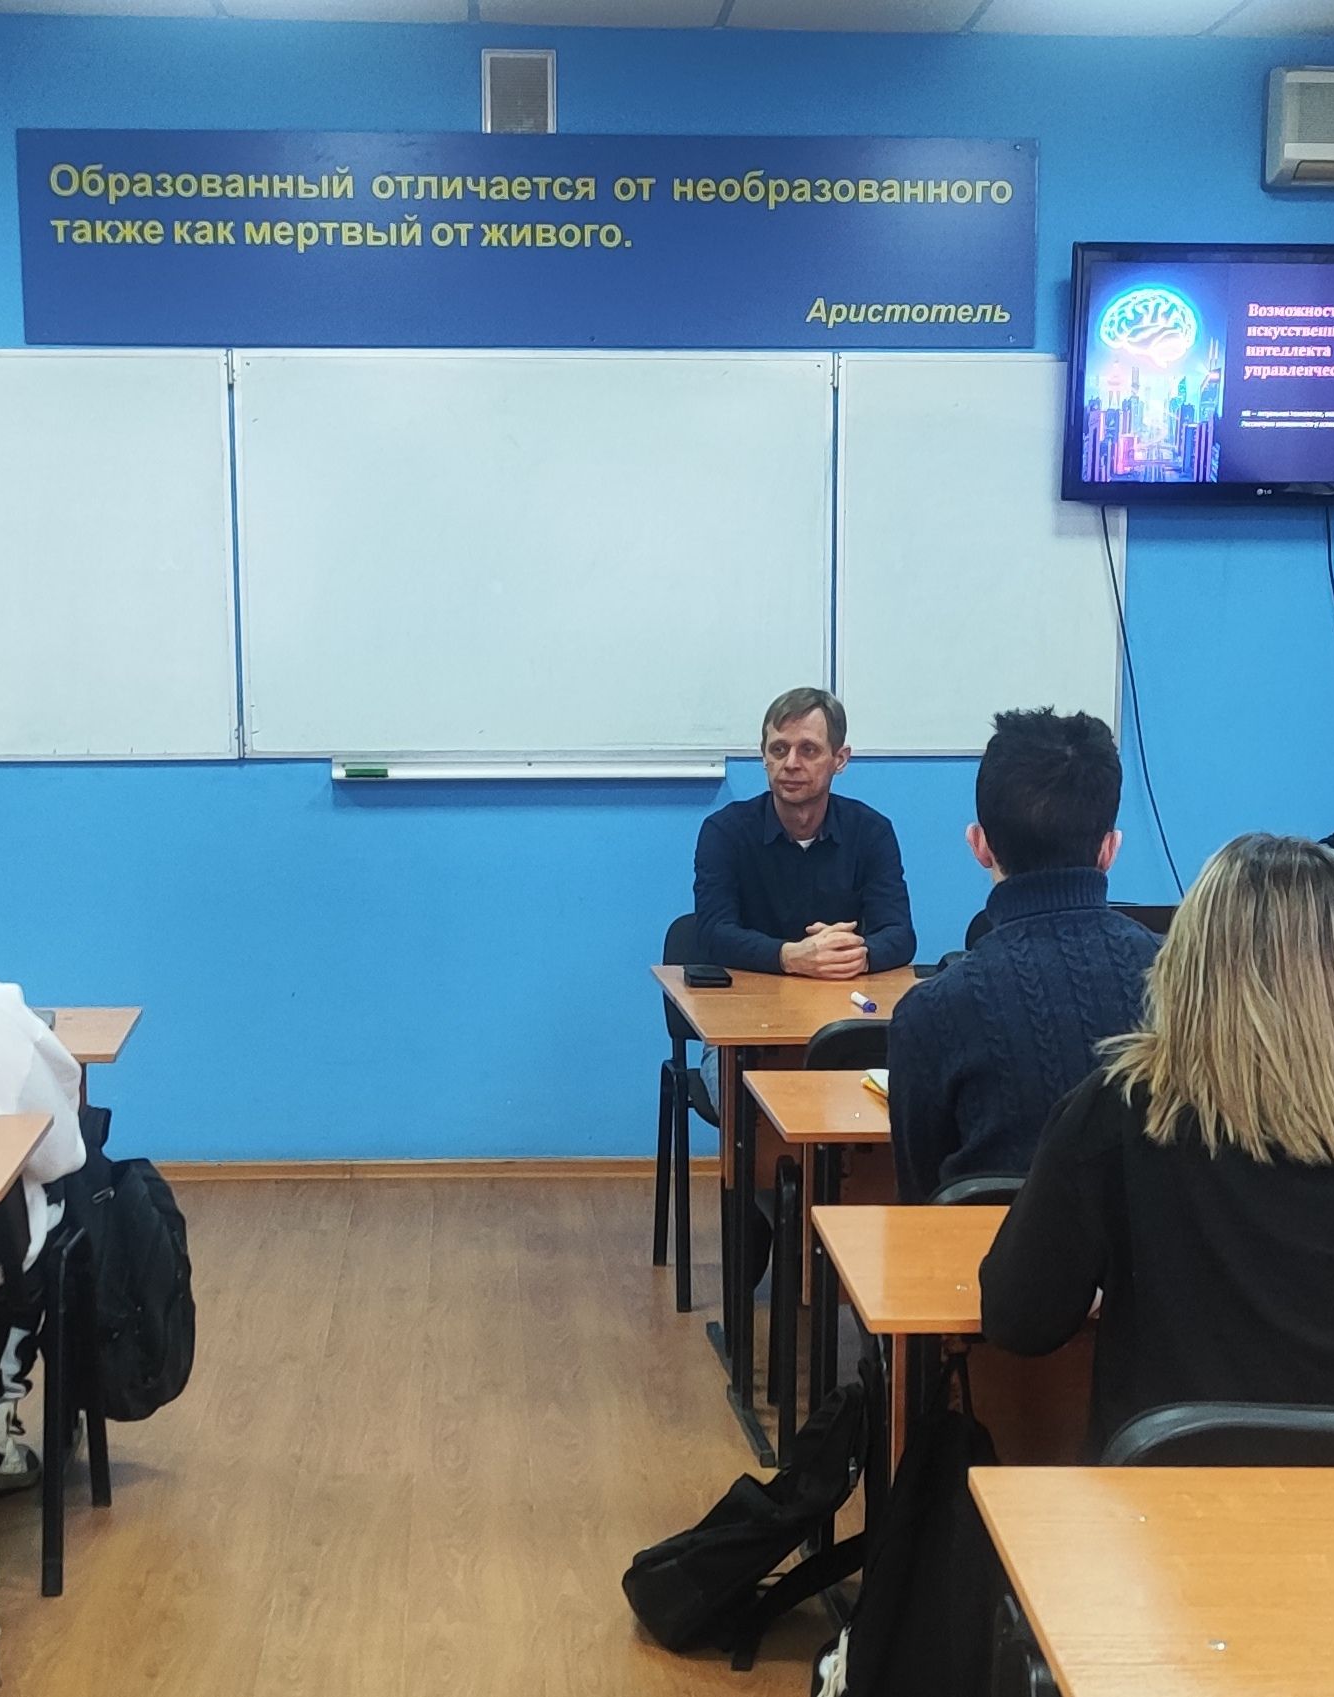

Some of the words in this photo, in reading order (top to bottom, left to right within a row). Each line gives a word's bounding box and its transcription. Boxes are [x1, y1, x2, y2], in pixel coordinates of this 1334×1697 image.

[50, 163, 354, 205] Образованный
[371, 174, 596, 201] отличается
[613, 177, 657, 201] от
[672, 169, 1014, 210] необразованного
[50, 218, 165, 245] также
[173, 219, 236, 246] как
[244, 214, 423, 253] мертвый
[430, 221, 475, 248] от
[480, 222, 633, 249] живого.
[805, 297, 1013, 329] Аристотель
[1245, 345, 1332, 358] интеллекта
